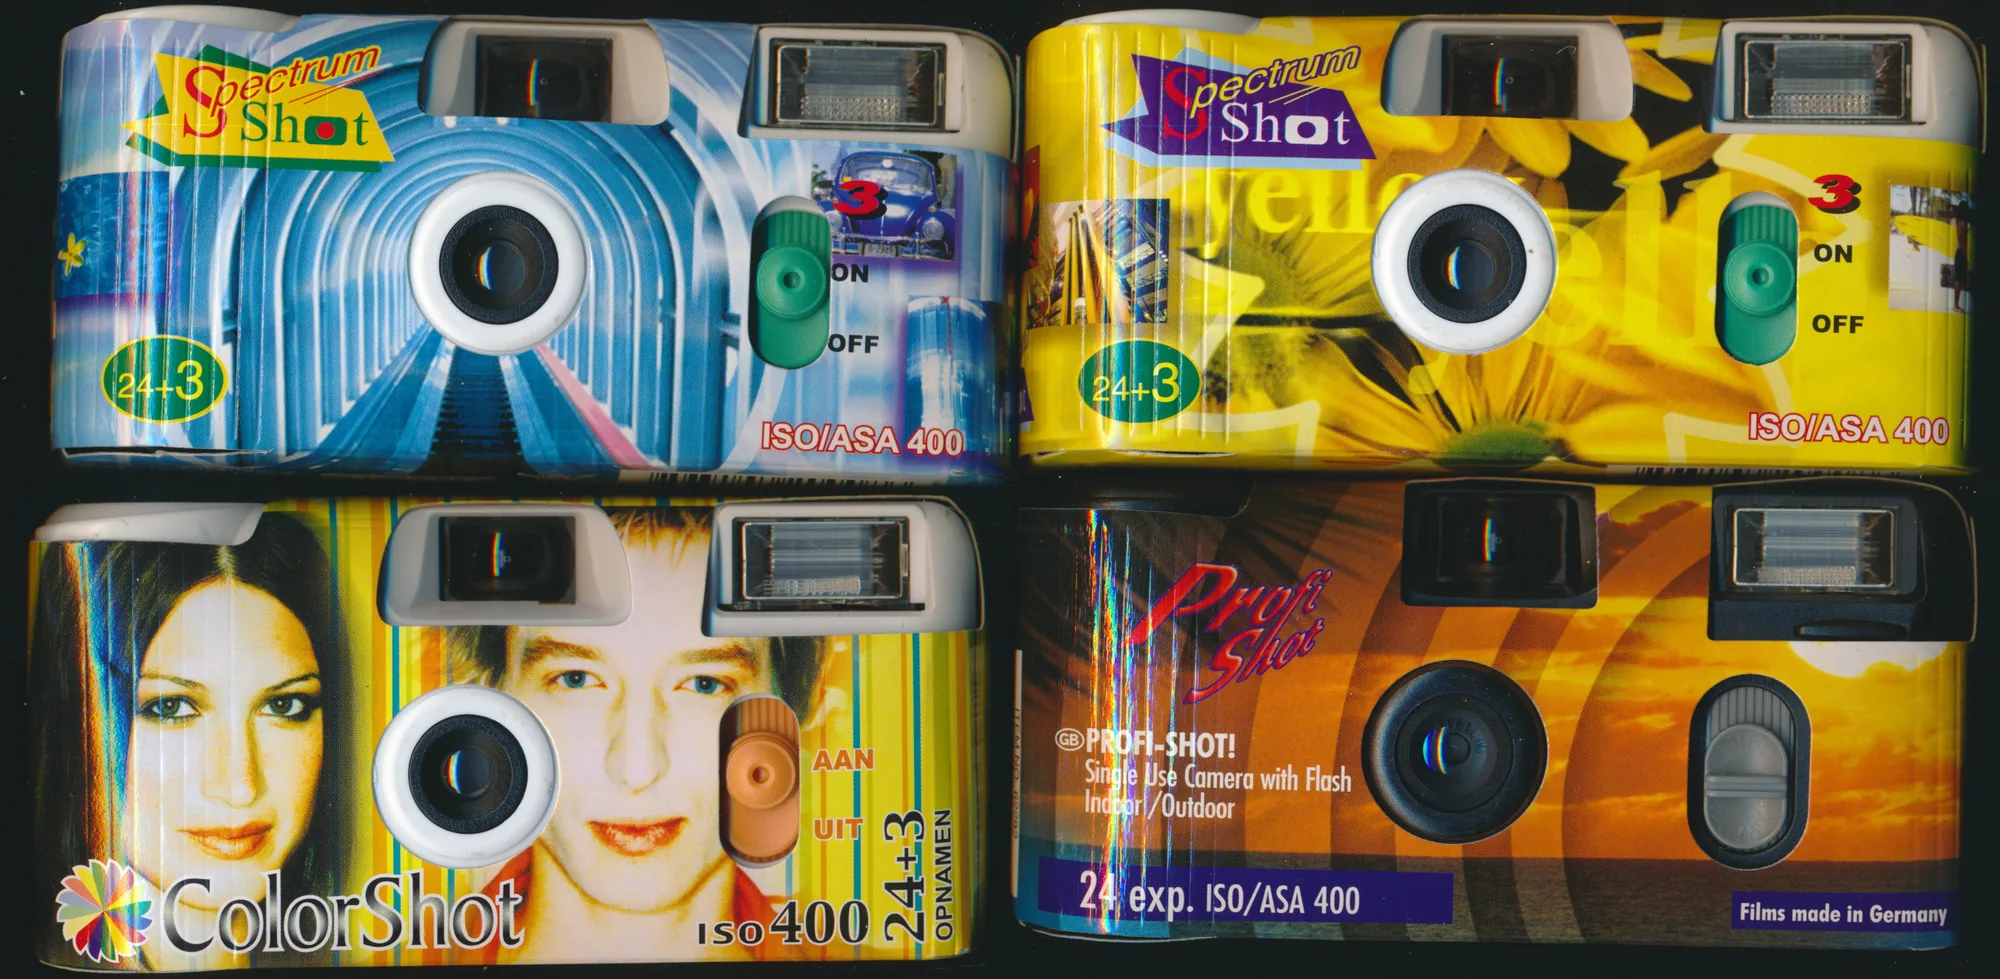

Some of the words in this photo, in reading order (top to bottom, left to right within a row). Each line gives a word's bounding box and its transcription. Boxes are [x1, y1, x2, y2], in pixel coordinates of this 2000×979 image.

[183, 45, 382, 138] Spectrum
[1162, 45, 1361, 138] Spectrum
[833, 180, 889, 220] 3
[1808, 174, 1862, 214] 3
[831, 263, 869, 283] ON
[1814, 245, 1853, 263] ON
[1812, 315, 1864, 334] OFF
[828, 334, 879, 354] OFF
[117, 360, 204, 401] 24+3
[1093, 362, 1180, 403] 24+3
[760, 420, 900, 456] ISO/ASA
[907, 427, 964, 457] 400
[1748, 411, 1889, 444] ISO/ASA
[1893, 416, 1950, 446] 400
[1121, 562, 1333, 648] Profi
[1059, 732, 1080, 747] GB
[1086, 727, 1236, 760] PROFI-SHOT!
[811, 748, 874, 772] AAN
[1085, 758, 1138, 791] Single
[1145, 764, 1177, 788] Use
[1184, 763, 1254, 790] Camera
[1261, 766, 1299, 792] with
[1305, 766, 1352, 793] Flash
[813, 818, 864, 841] UIT
[883, 809, 926, 944] 24+3
[933, 808, 953, 942] OPNAMEN
[161, 869, 525, 953] ColorShot
[1079, 871, 1117, 910] 24
[1129, 885, 1194, 922] exp.
[1206, 883, 1305, 916] ISO/ASA
[1313, 886, 1360, 915] 400
[1740, 902, 1785, 921] Films
[1792, 903, 1840, 922] made
[1847, 905, 1863, 922] in
[1869, 905, 1947, 926] Germany
[769, 900, 870, 945] 400
